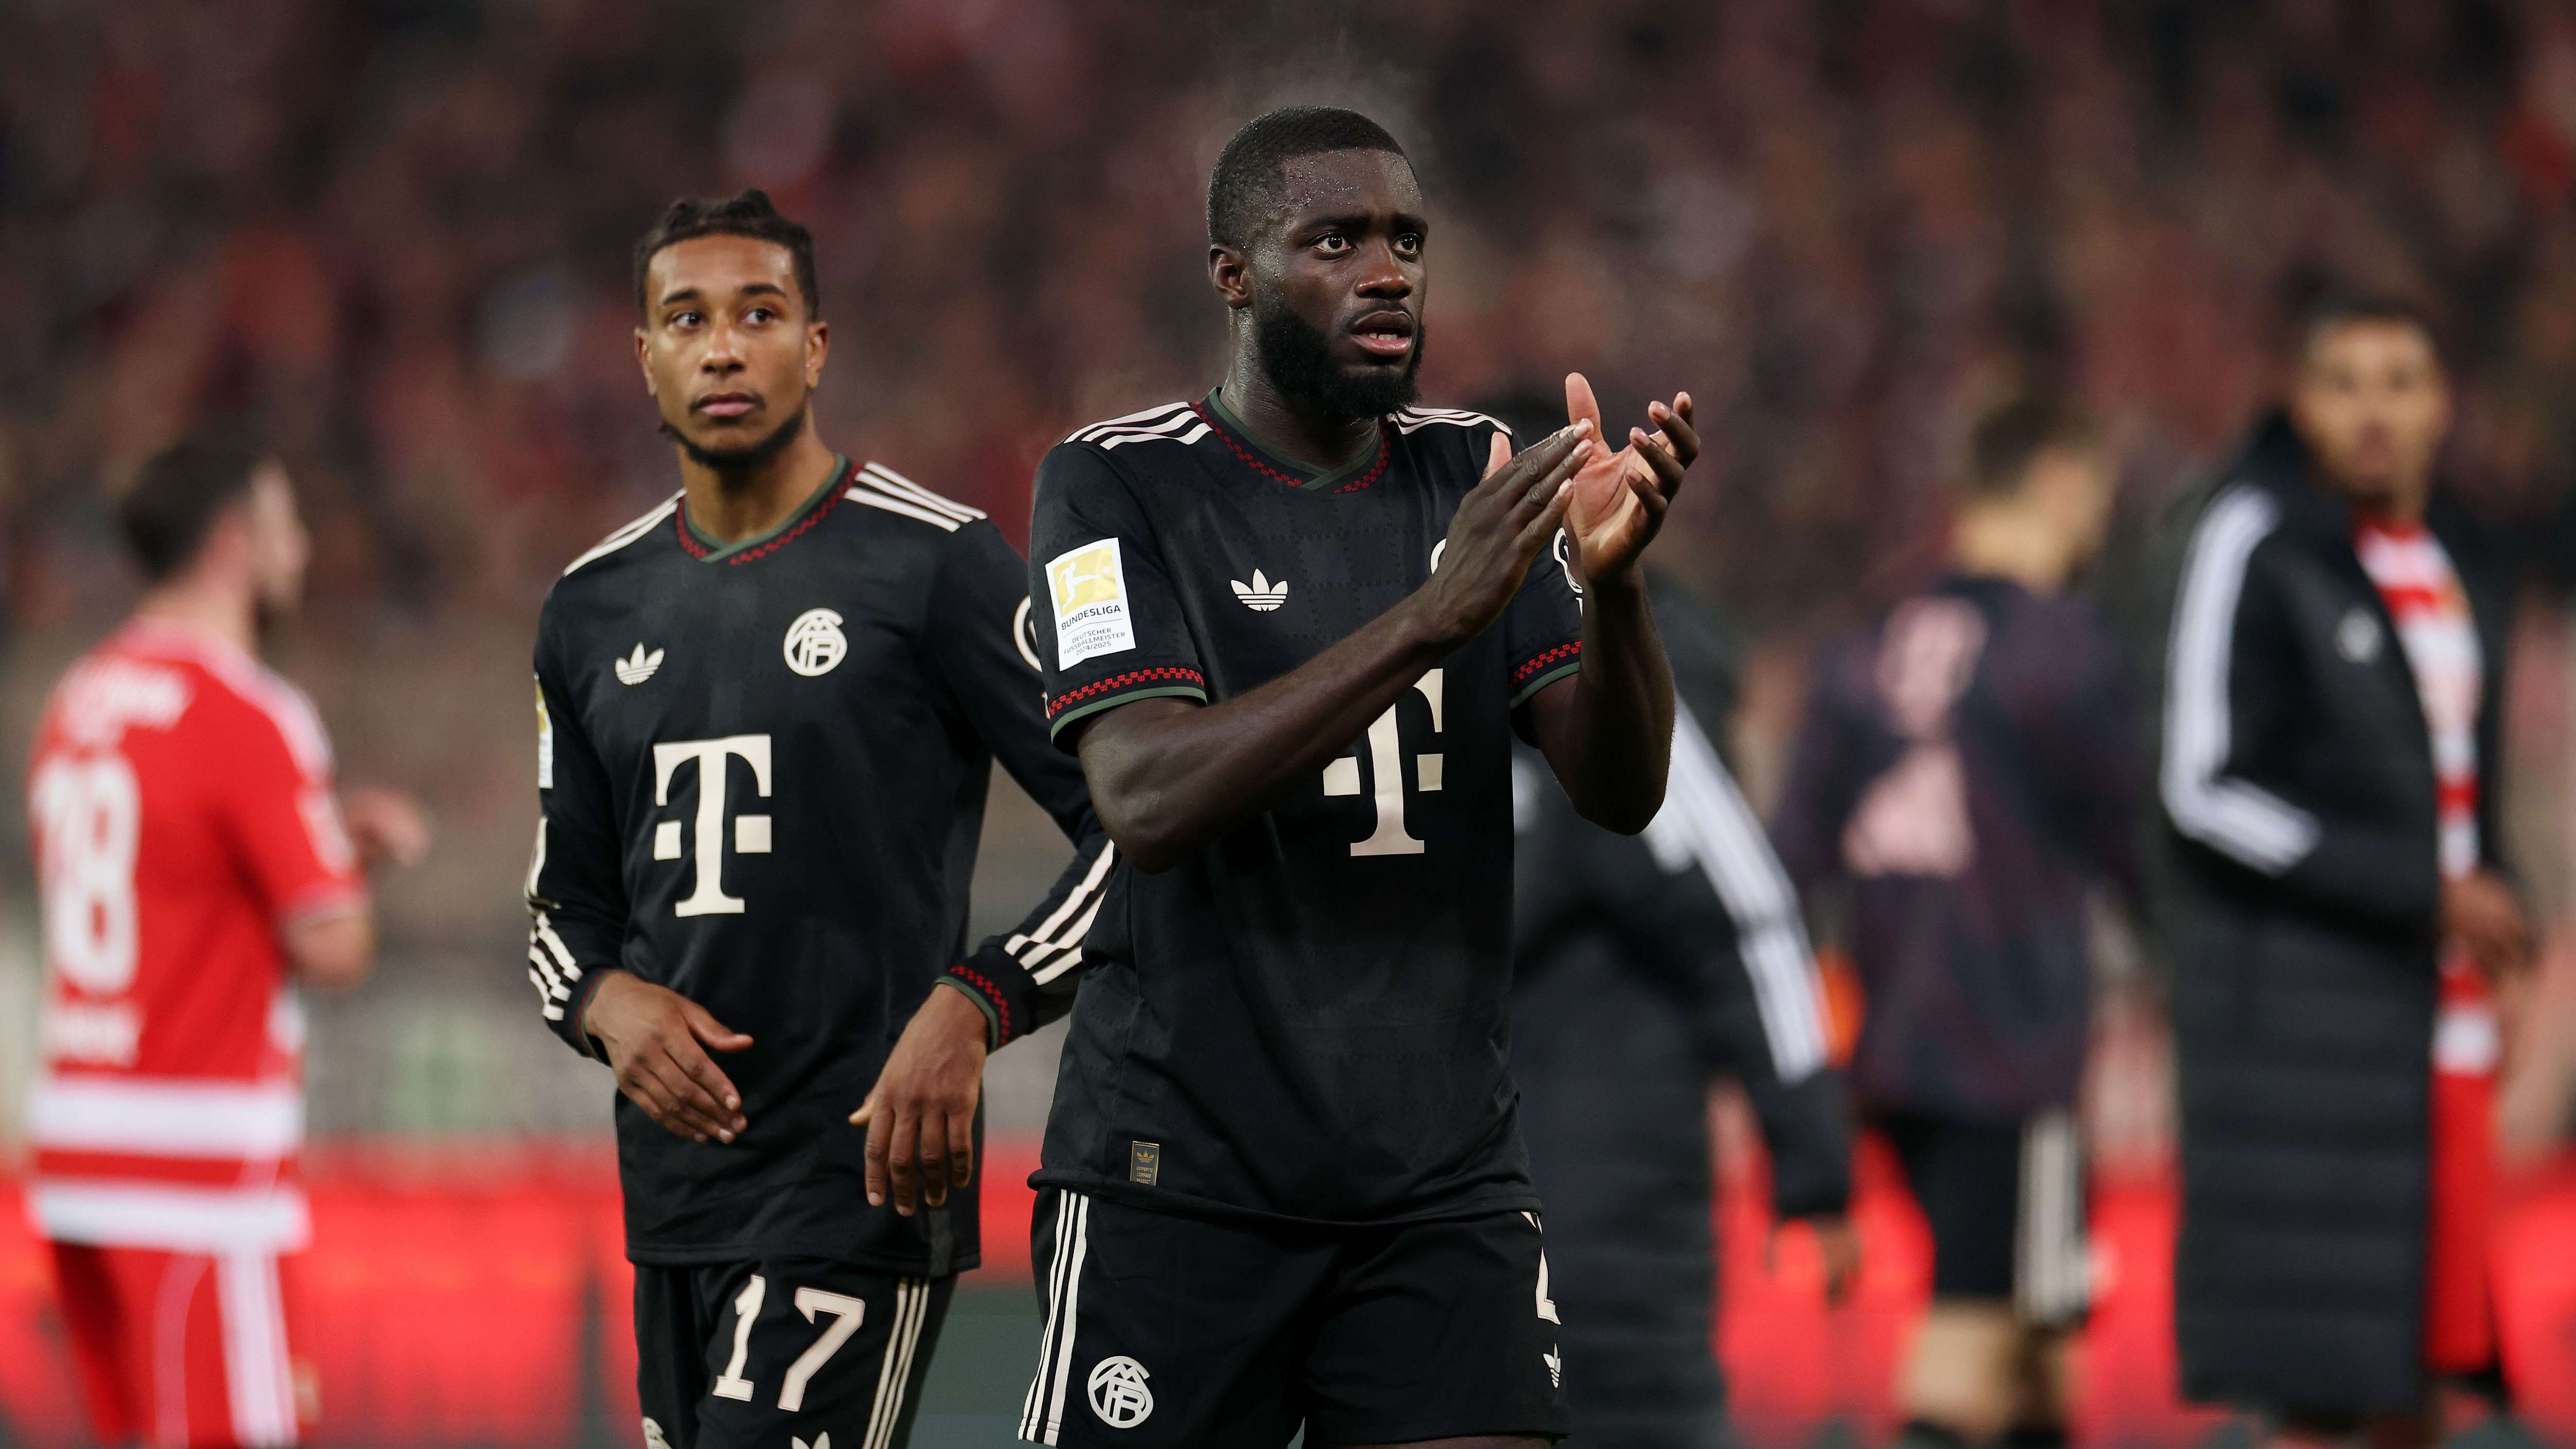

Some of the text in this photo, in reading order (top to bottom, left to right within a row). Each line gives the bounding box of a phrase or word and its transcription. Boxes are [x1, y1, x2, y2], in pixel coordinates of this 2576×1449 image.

[1061, 605, 1121, 630] BUNDESLIGA
[1064, 632, 1126, 655] FUSSBALLMEISTER
[1072, 627, 1112, 643] DEUTSCHER
[1076, 641, 1112, 656] 2024/2025
[653, 734, 772, 918] T
[712, 1273, 866, 1412] 17
